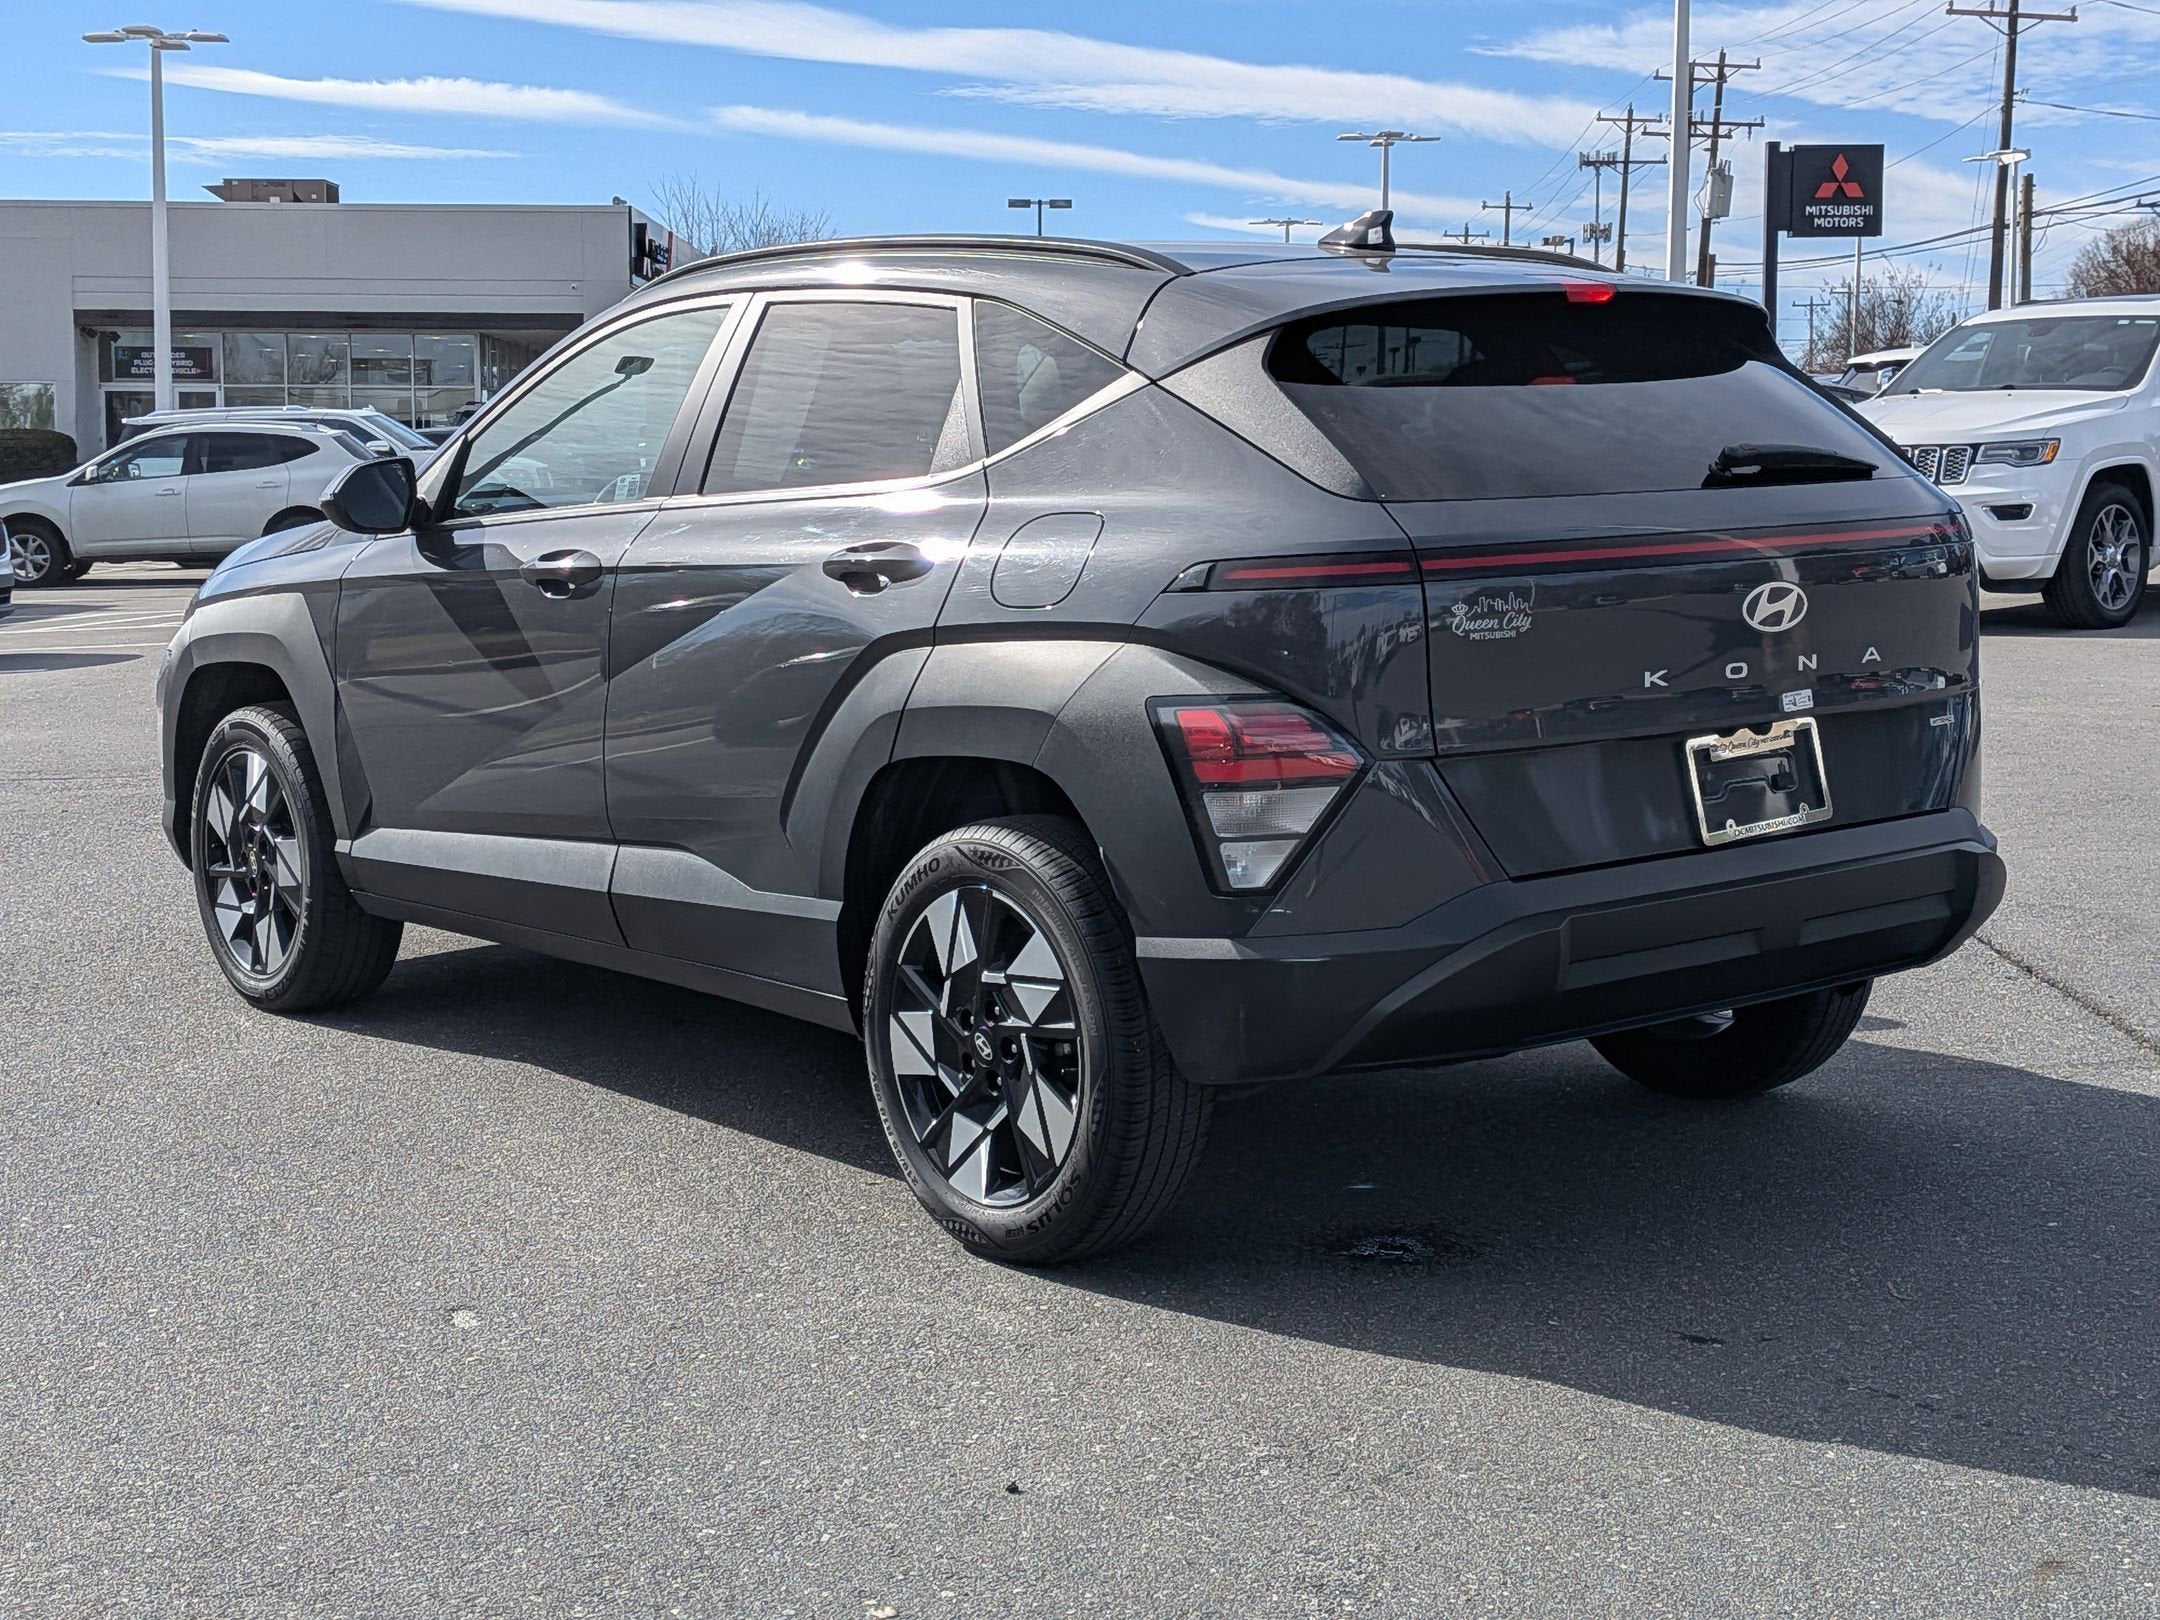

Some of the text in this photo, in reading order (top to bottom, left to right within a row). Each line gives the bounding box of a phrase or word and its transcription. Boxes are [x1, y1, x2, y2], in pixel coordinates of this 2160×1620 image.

[1805, 205, 1874, 216] MITSUBISHI
[1814, 217, 1864, 228] MOTORS
[1452, 611, 1532, 636] Queen City
[1469, 630, 1516, 640] MITSUBISHI
[1644, 646, 1882, 688] KONA
[887, 857, 941, 921] KUMHO
[1026, 1169, 1081, 1235] SOLUS
